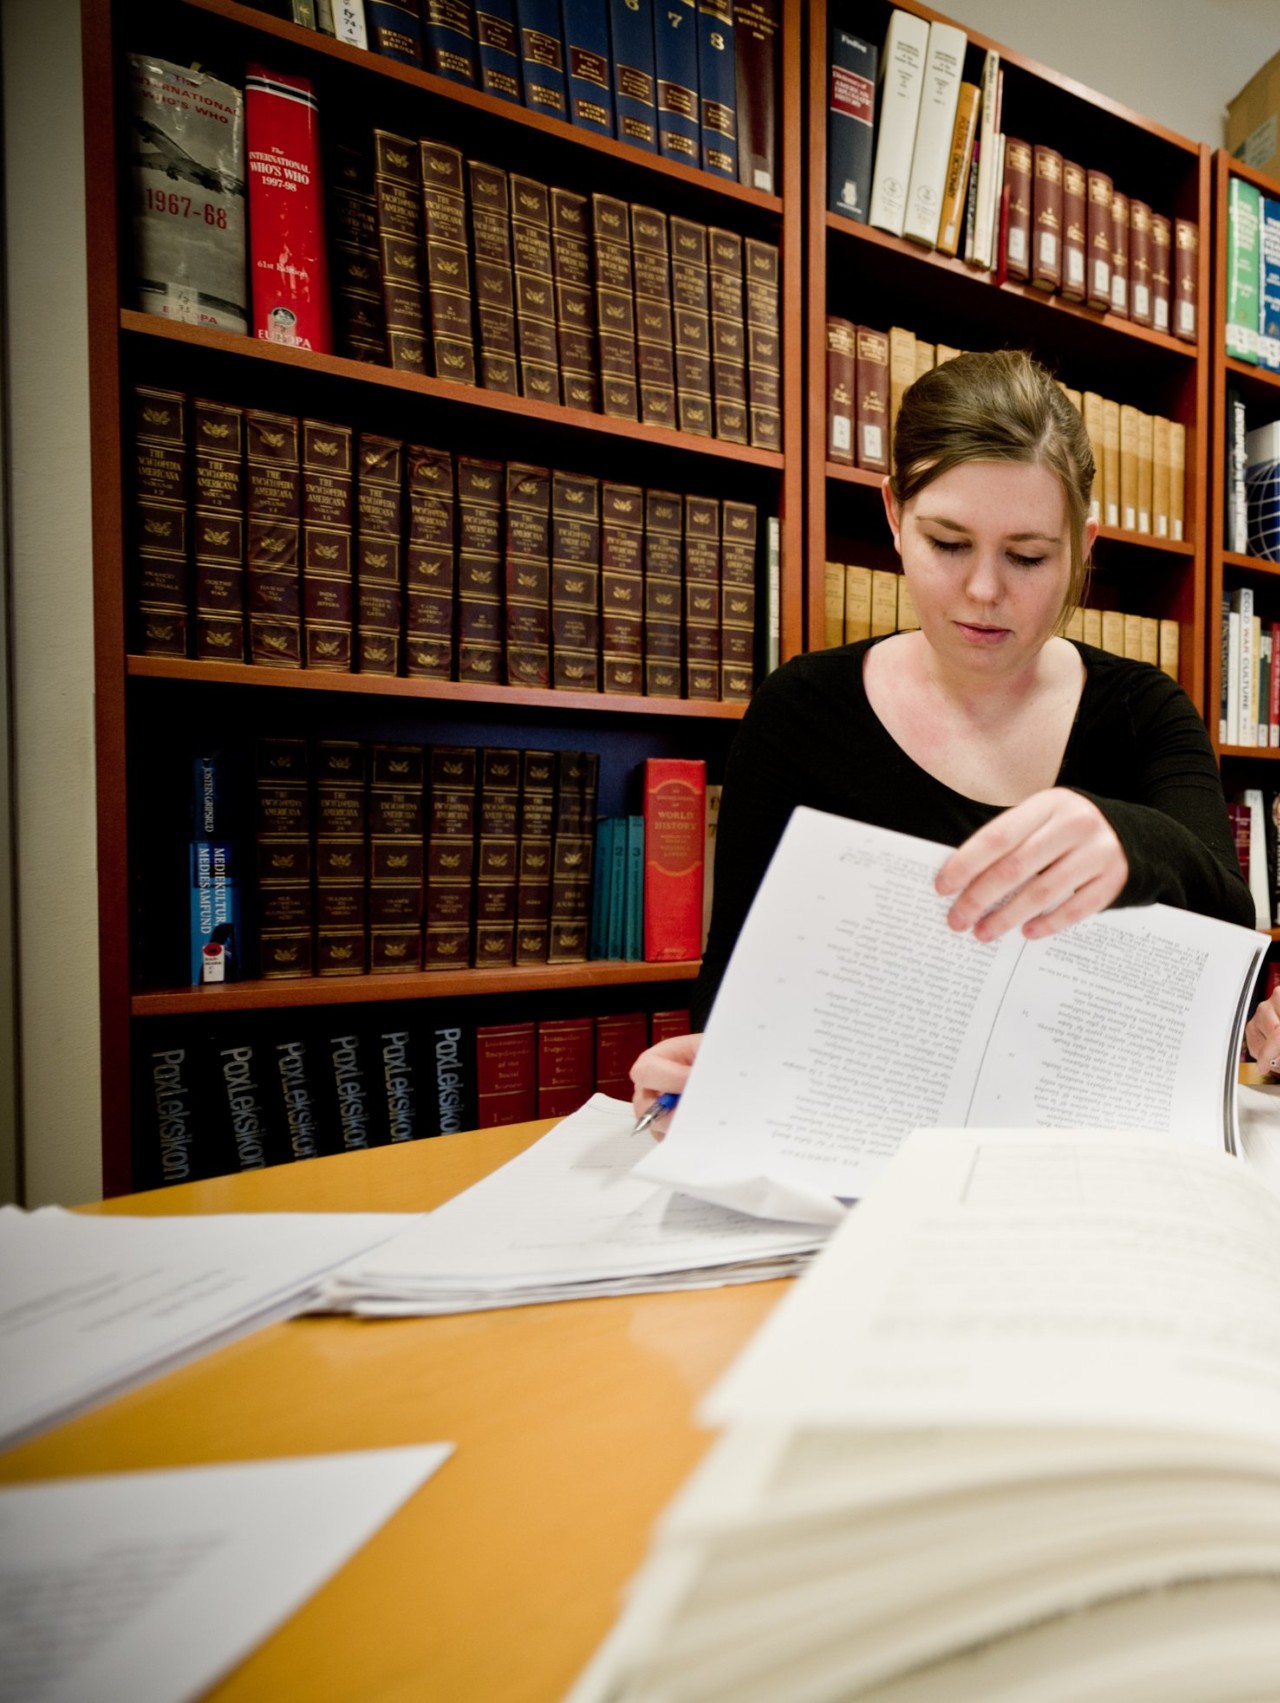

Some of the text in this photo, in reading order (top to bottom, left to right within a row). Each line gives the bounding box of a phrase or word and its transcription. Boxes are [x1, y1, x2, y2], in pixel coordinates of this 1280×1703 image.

[667, 11, 683, 29] 7
[710, 32, 725, 51] 8
[195, 106, 229, 125] WHO
[248, 152, 311, 174] INTERNATIONAL
[250, 162, 310, 185] WHO'S WHO
[262, 176, 298, 192] 1997-98
[144, 188, 228, 230] 1967-68
[257, 260, 275, 270] 61st
[1241, 591, 1251, 711] COLD WAR CULTURE
[658, 811, 694, 820] WORLD
[654, 821, 697, 831] HISTORY
[199, 848, 211, 935] MEDIESAMFUND
[152, 1049, 193, 1181] PaxLeksikon
